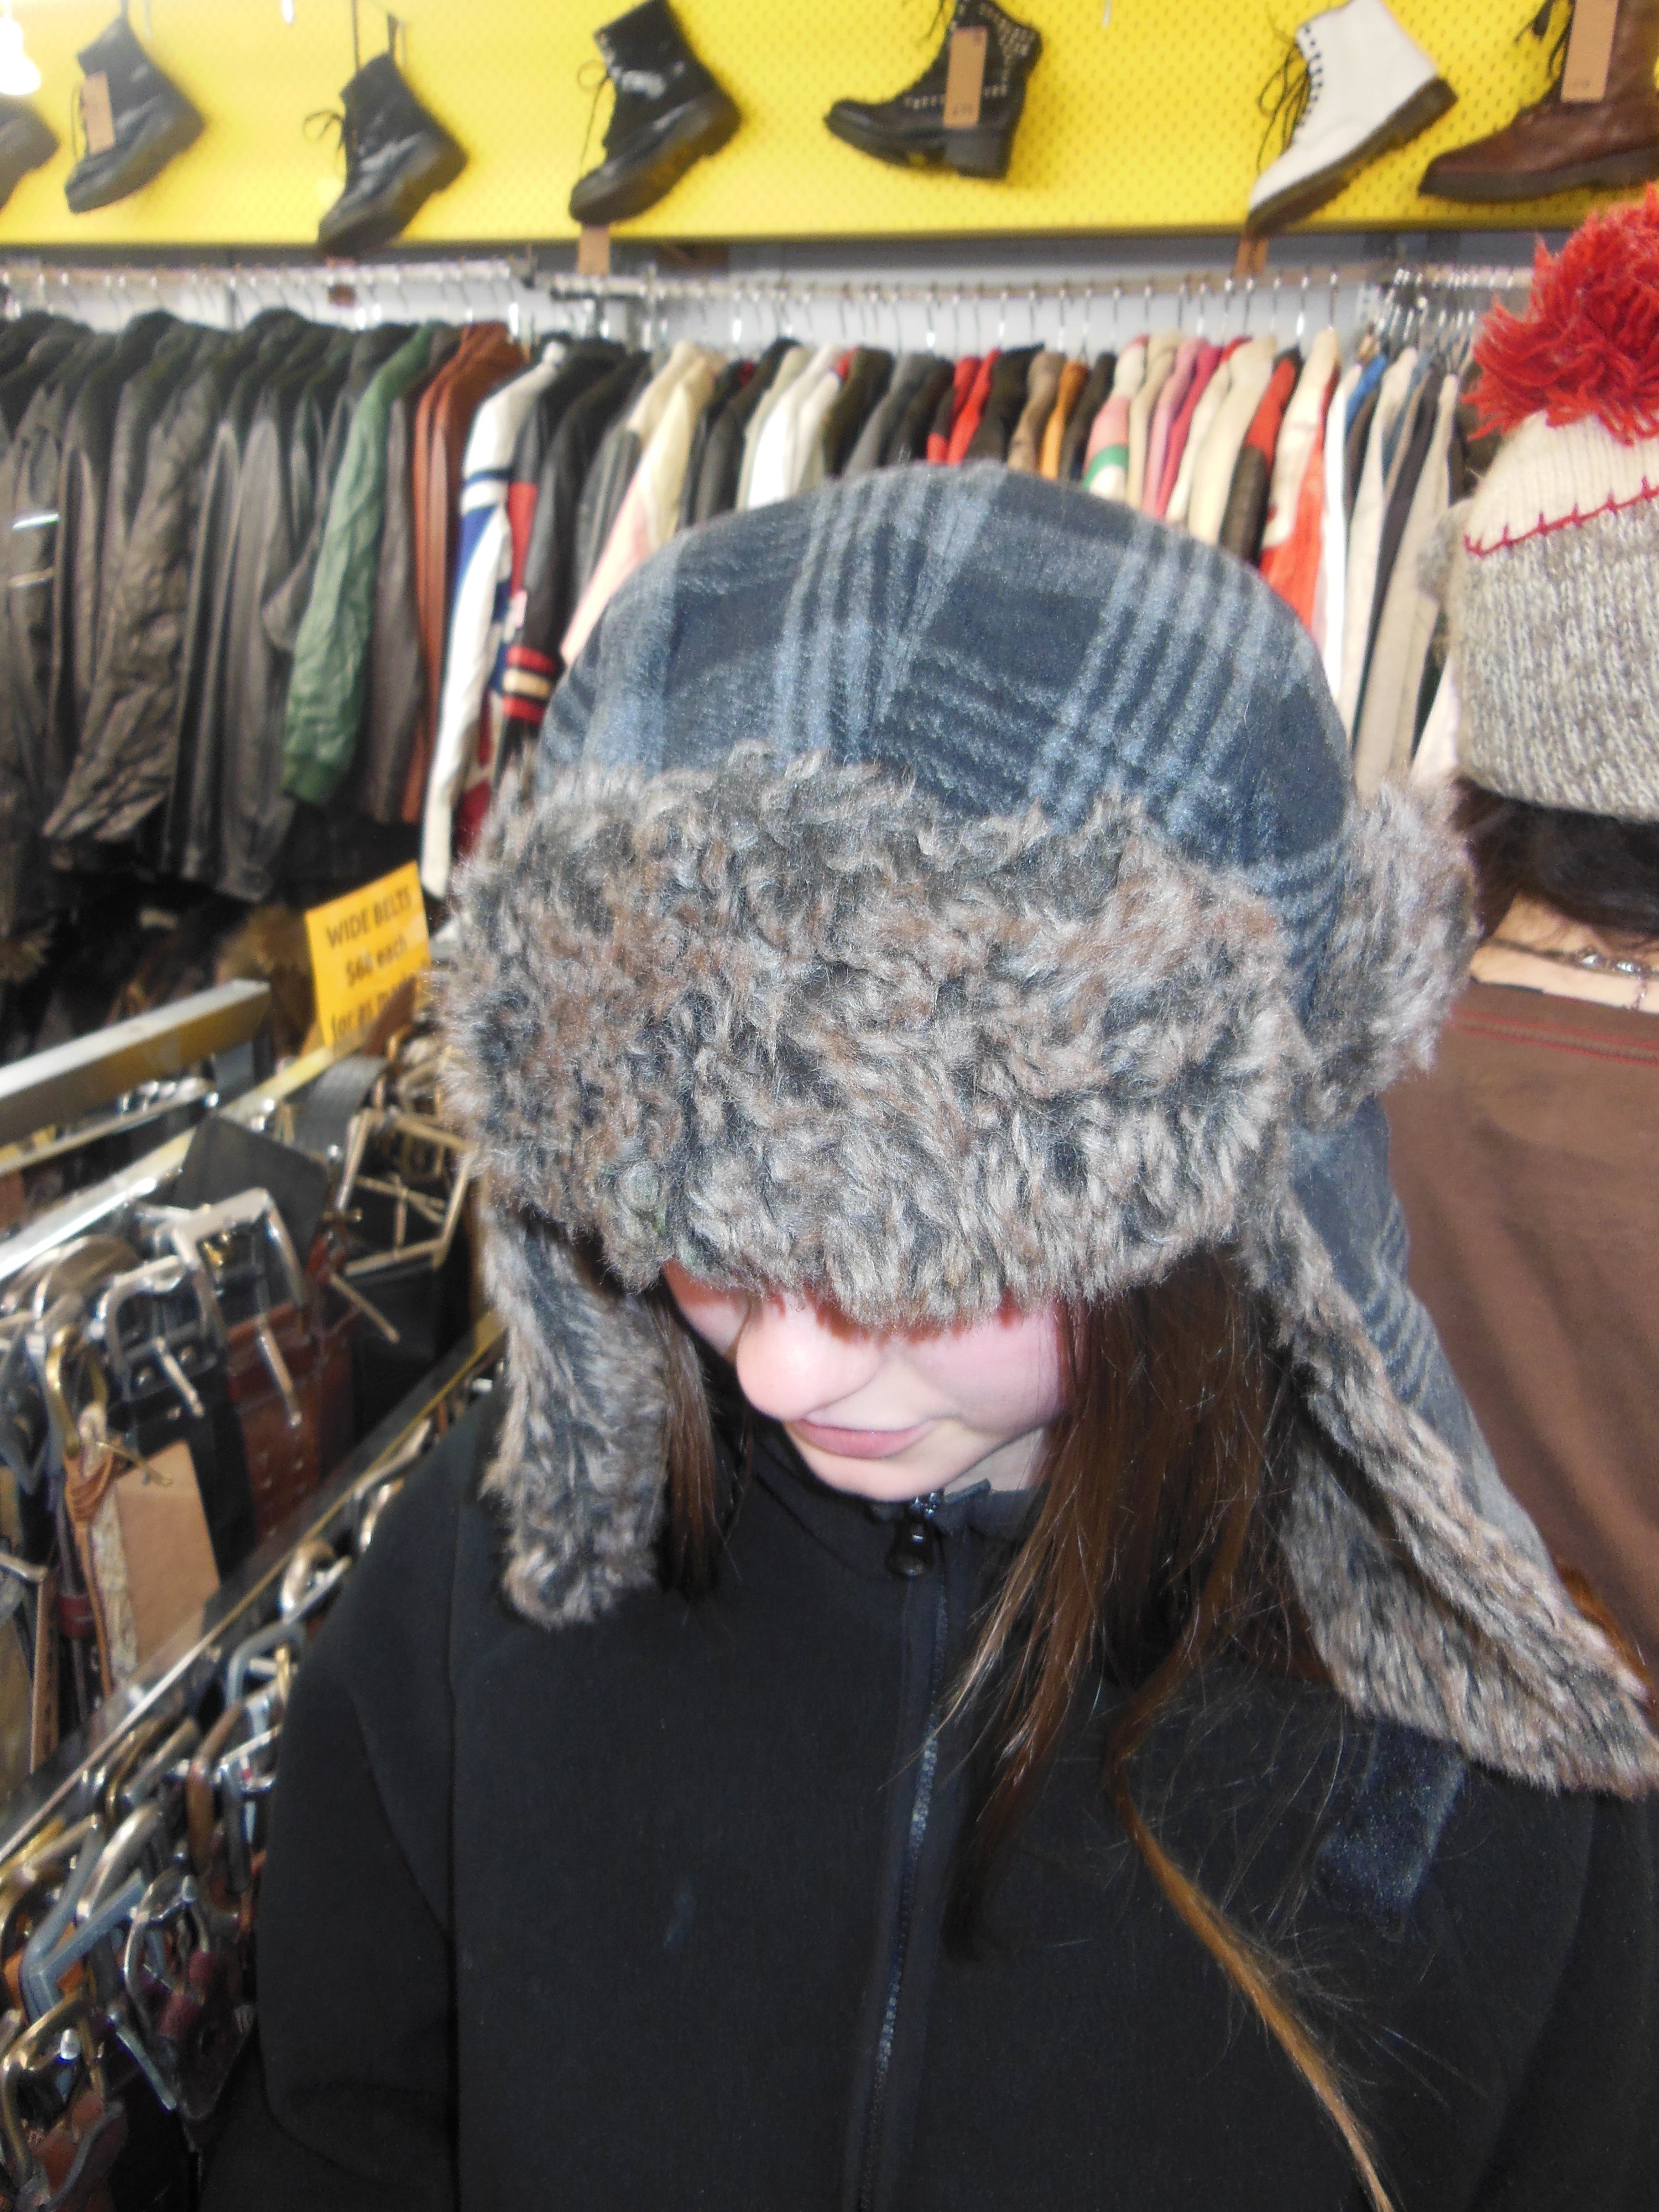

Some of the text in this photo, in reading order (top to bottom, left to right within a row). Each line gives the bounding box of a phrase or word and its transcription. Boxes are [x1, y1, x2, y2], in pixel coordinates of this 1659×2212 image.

[326, 885, 411, 948] WIDE BELTS
[377, 933, 408, 967] each
